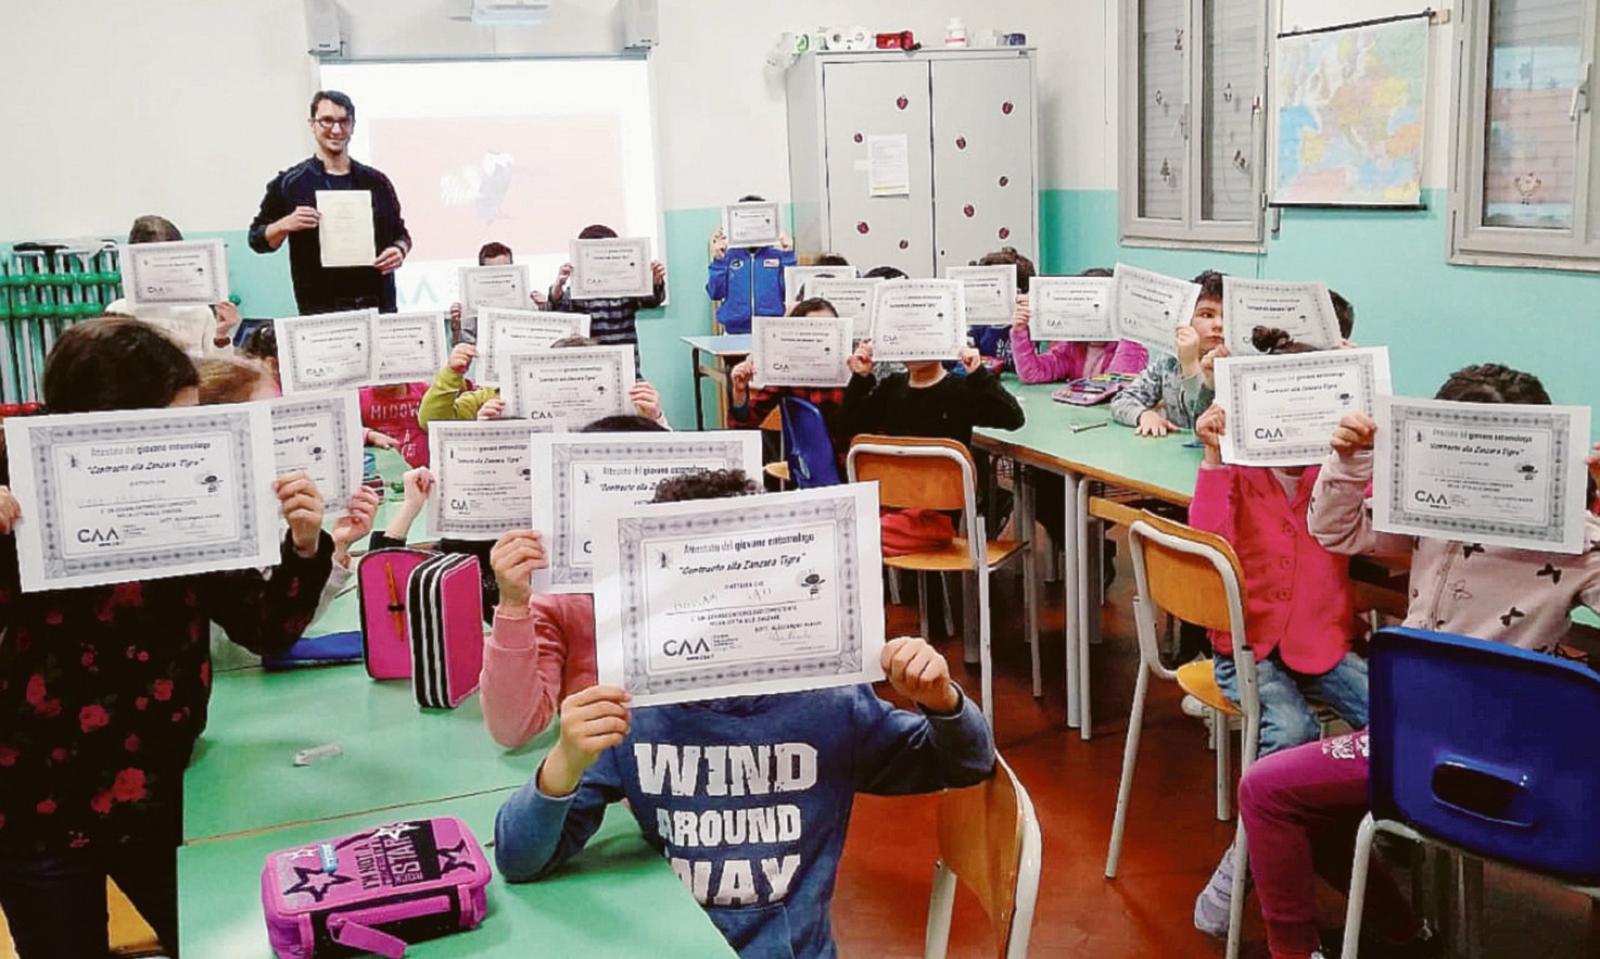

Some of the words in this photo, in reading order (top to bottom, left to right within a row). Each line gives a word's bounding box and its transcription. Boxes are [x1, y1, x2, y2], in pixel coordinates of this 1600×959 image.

[1254, 427, 1283, 440] CAA
[1414, 489, 1448, 505] CAA
[77, 527, 119, 543] CAA
[734, 538, 766, 552] giovane
[727, 561, 742, 571] alla
[743, 558, 777, 570] Zanzara
[662, 637, 711, 656] CAA
[634, 742, 818, 797] WIND
[656, 804, 801, 847] AROUND
[353, 843, 370, 851] A
[383, 835, 421, 874] STAR
[355, 854, 376, 874] NOT
